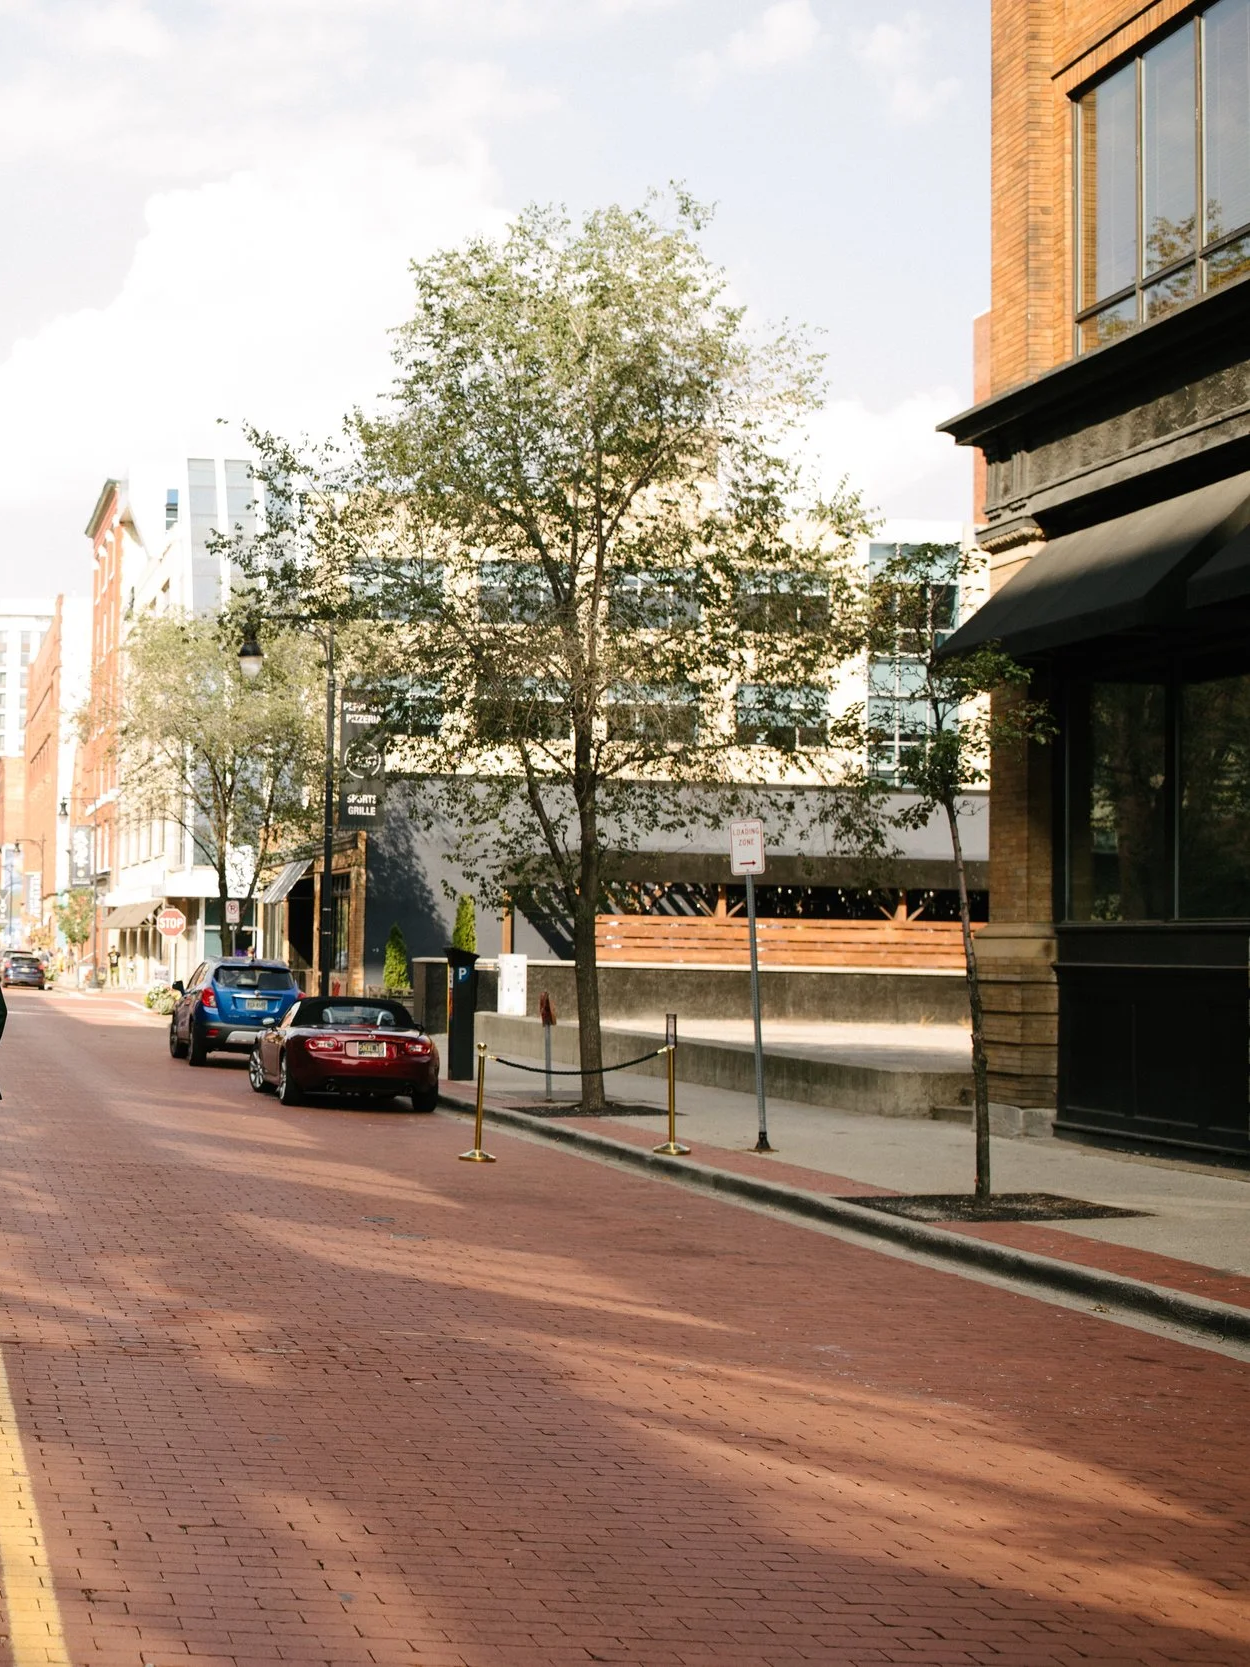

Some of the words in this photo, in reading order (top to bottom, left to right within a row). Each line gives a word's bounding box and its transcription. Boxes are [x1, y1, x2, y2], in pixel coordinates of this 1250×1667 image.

[346, 714, 381, 724] PIZZERIA
[347, 794, 377, 804] SPORTS
[348, 806, 376, 816] GRILLE
[733, 828, 759, 836] LOADING
[159, 917, 184, 929] STOP
[459, 967, 467, 980] P
